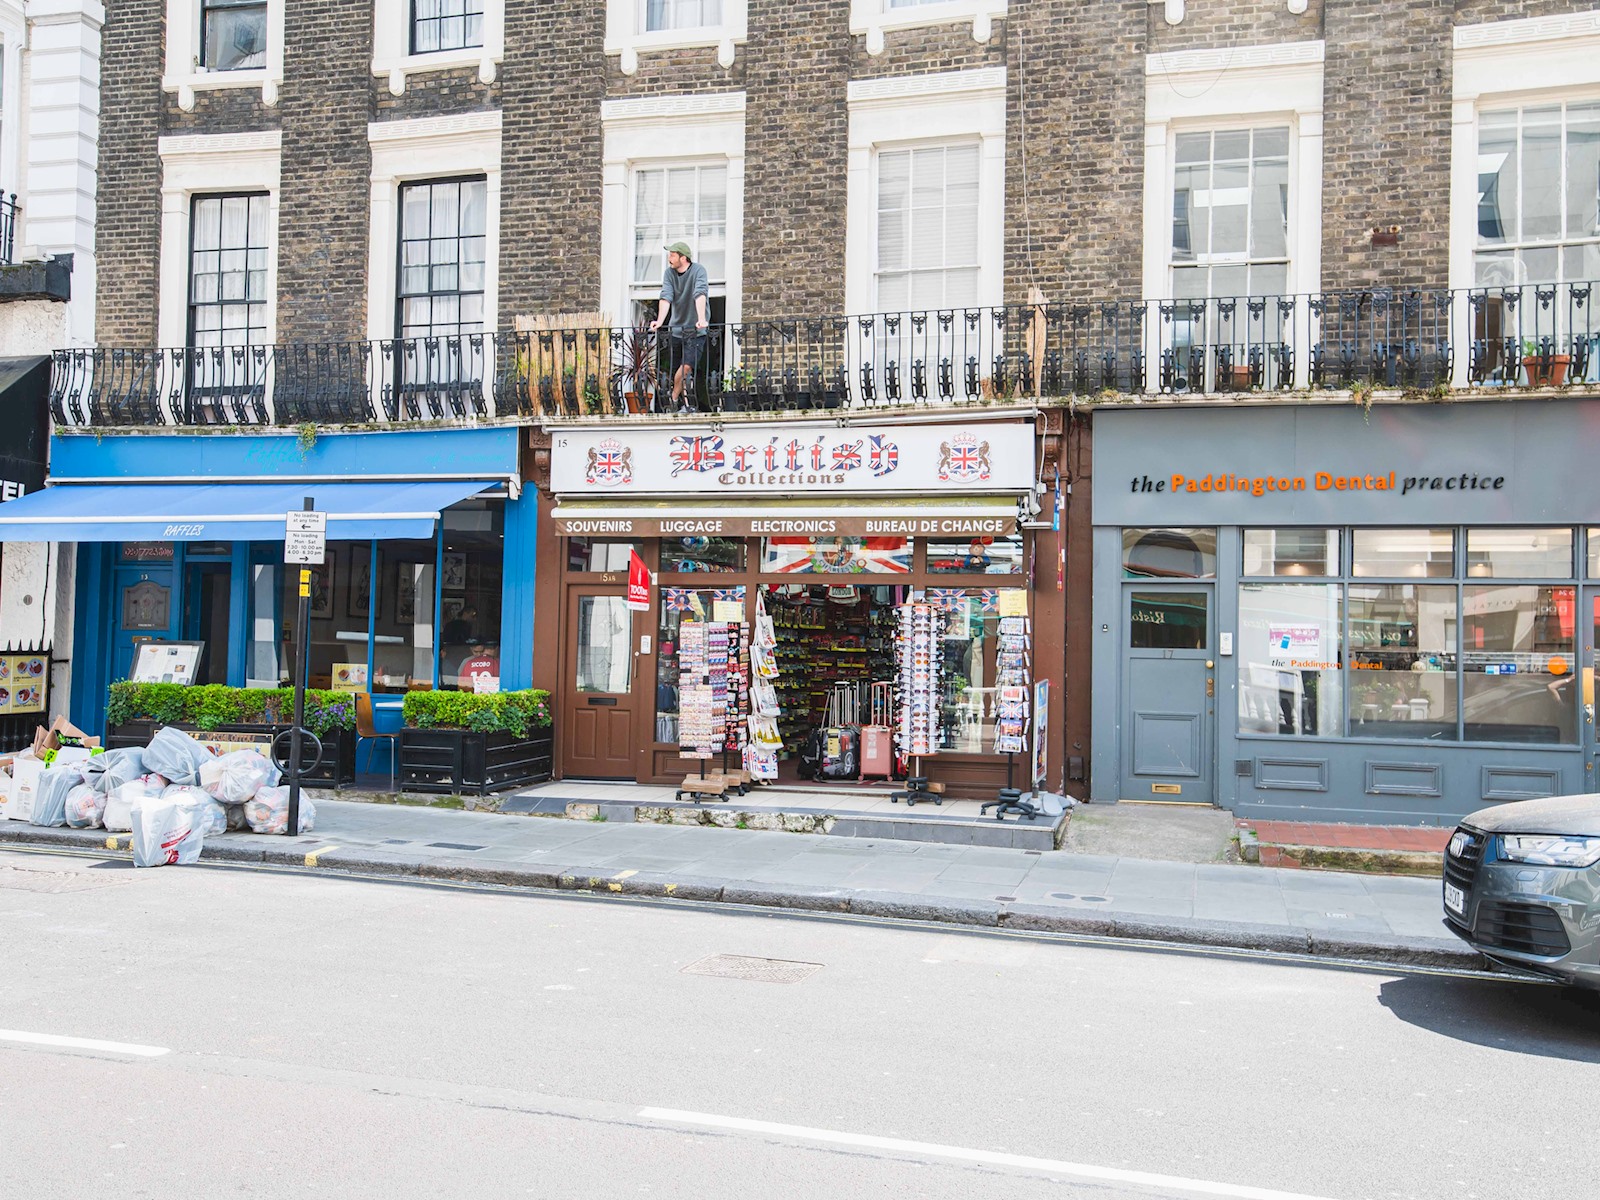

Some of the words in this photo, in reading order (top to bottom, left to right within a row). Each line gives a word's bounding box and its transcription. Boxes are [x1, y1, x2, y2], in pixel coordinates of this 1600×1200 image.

[557, 439, 568, 448] 15
[669, 433, 899, 478] British
[718, 472, 845, 486] Collections
[1130, 475, 1166, 493] the
[1171, 473, 1306, 497] Paddington
[1314, 470, 1396, 490] Dental
[1401, 472, 1505, 495] practice
[163, 524, 205, 537] RAFFLES
[566, 520, 633, 533] SOUVENIRS
[660, 520, 722, 533] LUGGAGE
[751, 520, 836, 532] ELECTRONICS
[866, 520, 917, 532] BUREAU
[920, 520, 938, 532] DE
[941, 520, 1003, 532] CHANGE
[1271, 659, 1286, 667] the
[1290, 659, 1342, 670] Paddington
[1351, 660, 1383, 670] Dental
